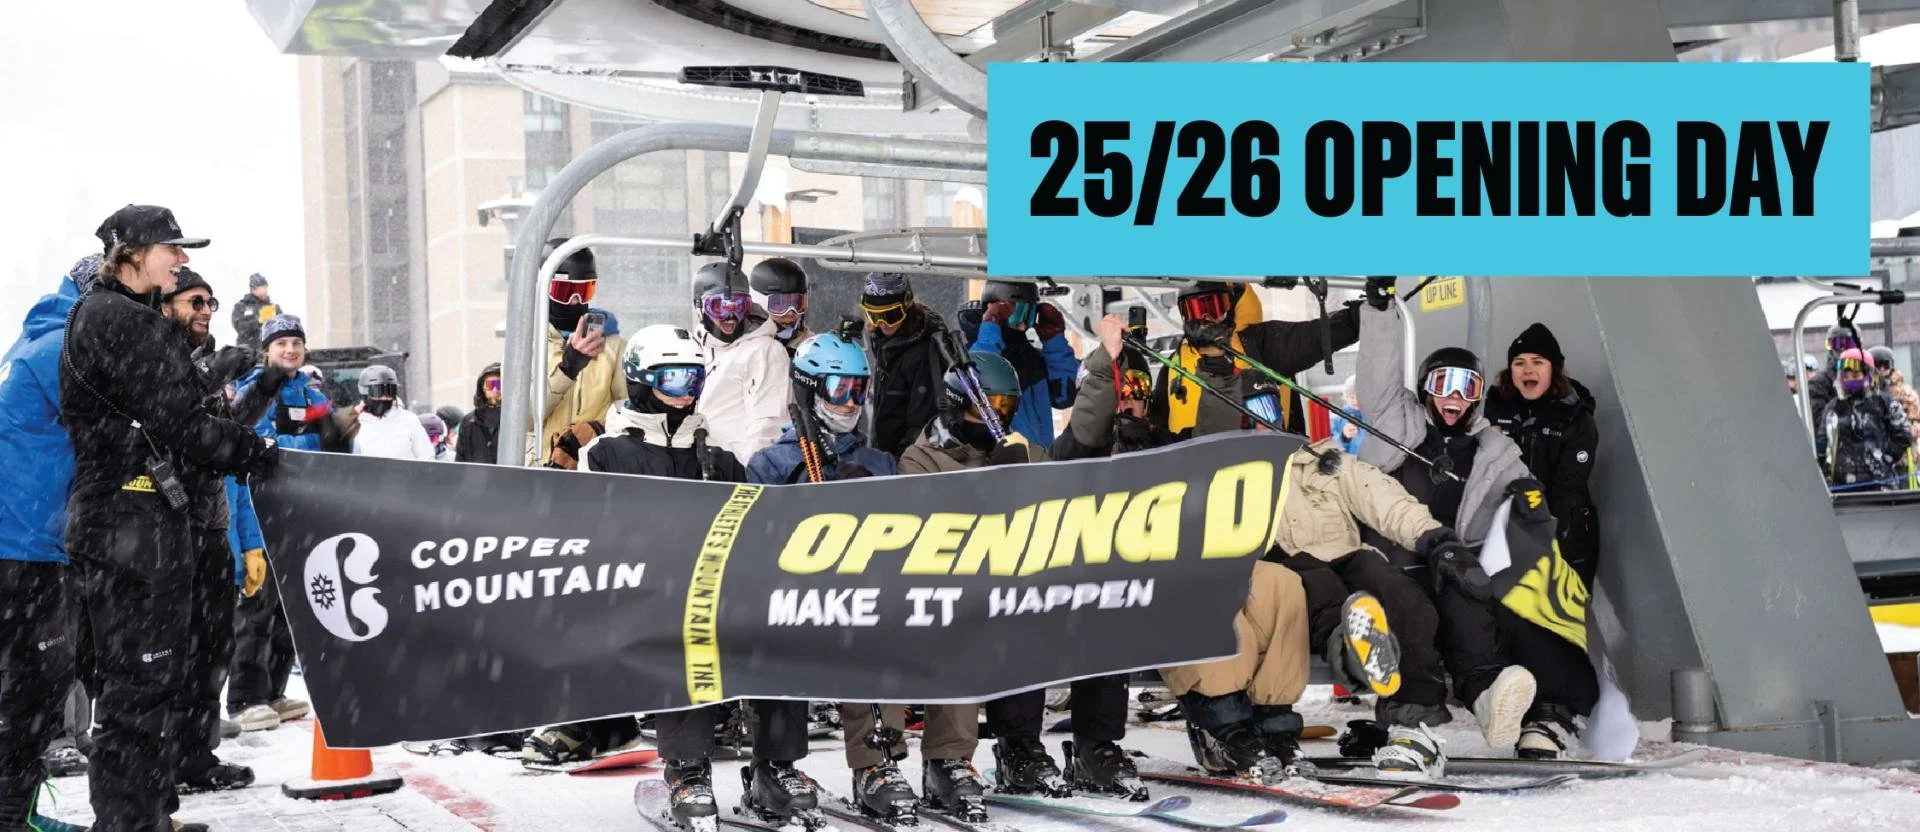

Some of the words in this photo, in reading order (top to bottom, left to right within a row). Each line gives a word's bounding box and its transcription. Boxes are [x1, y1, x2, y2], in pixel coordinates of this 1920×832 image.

[1426, 286, 1437, 304] UP
[1439, 281, 1458, 302] LINE
[793, 370, 818, 388] SMITH
[410, 535, 591, 569] COPPER
[778, 481, 1187, 576] OPENING
[414, 563, 646, 613] MOUNTAIN
[689, 552, 724, 646] MOUNTAIN
[767, 587, 881, 626] MAKE
[905, 587, 963, 627] IT
[988, 577, 1155, 618] HAPPEN
